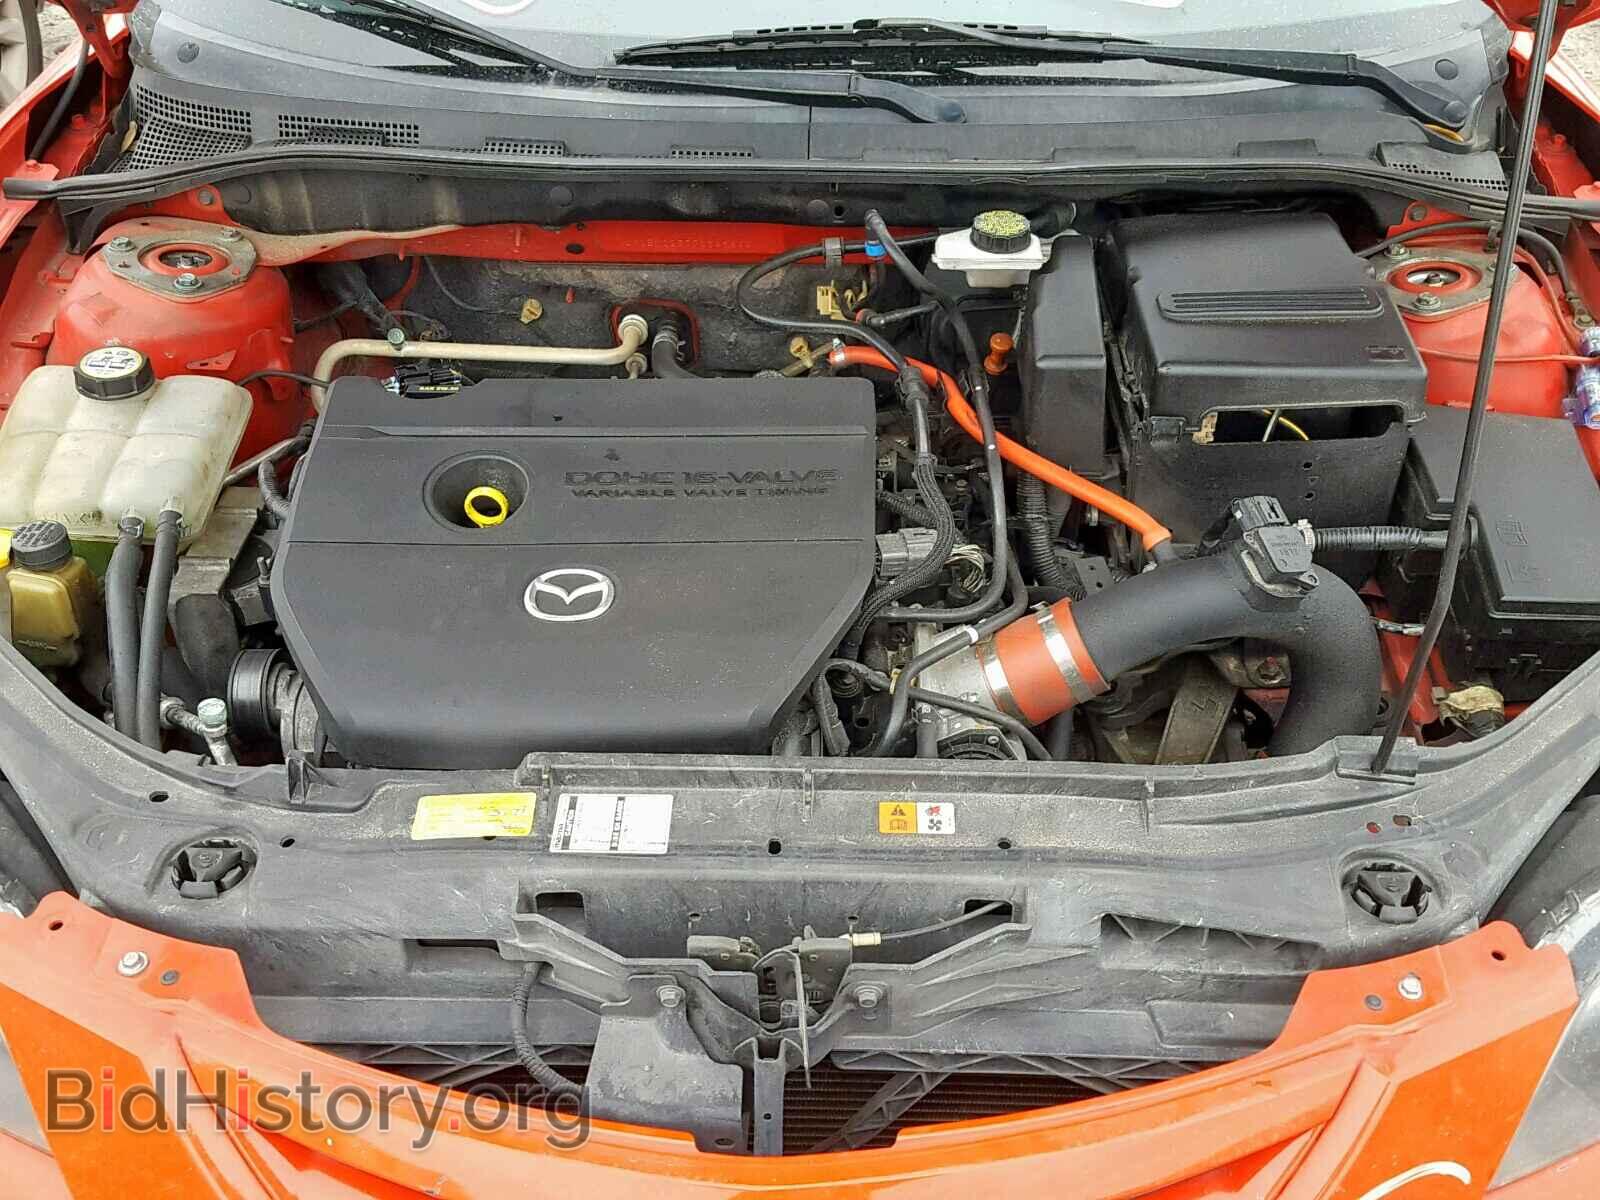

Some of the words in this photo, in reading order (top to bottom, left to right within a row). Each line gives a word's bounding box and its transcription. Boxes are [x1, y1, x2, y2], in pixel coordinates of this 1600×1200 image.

[565, 471, 675, 486] DOHC
[682, 469, 839, 485] 16-VALVE
[571, 488, 675, 498] VARIABLE
[683, 488, 746, 498] VALVE
[757, 487, 828, 497] TIMING
